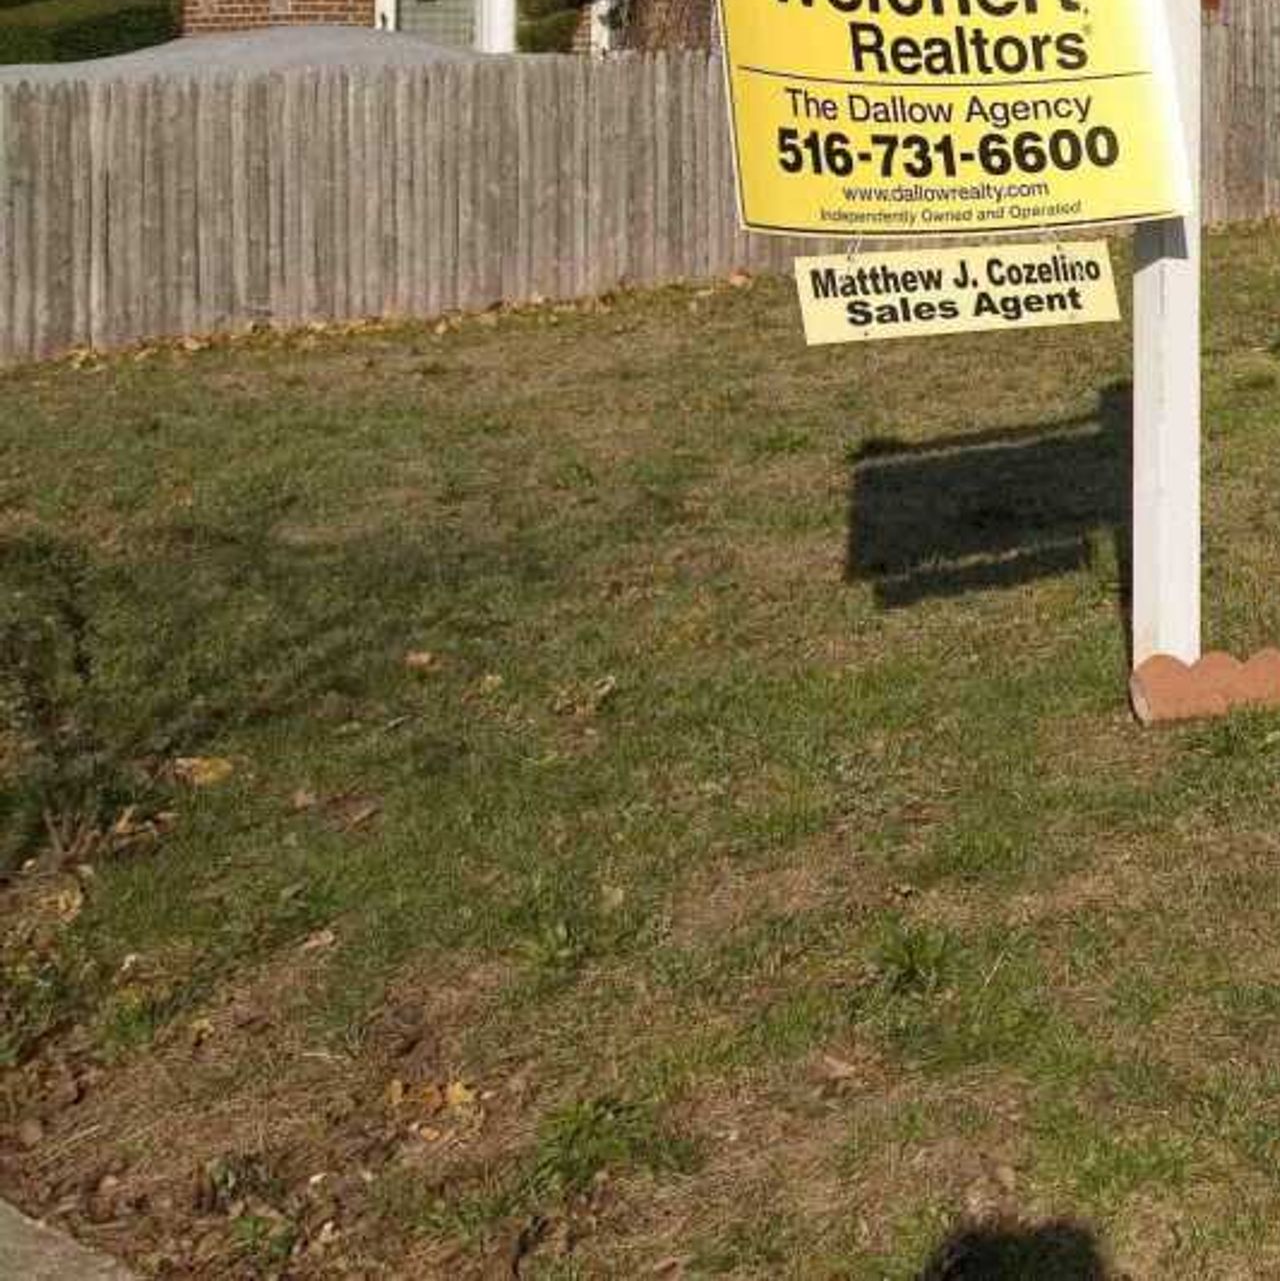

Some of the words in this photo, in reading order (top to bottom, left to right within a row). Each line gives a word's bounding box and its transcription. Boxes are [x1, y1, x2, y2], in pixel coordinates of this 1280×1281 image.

[785, 88, 838, 120] The
[849, 94, 953, 124] Dallow
[965, 95, 1092, 128] Agency
[777, 126, 1120, 179] 516-731-6600
[843, 181, 1050, 204] www.dallowrealty.com
[820, 208, 917, 224] Independently
[921, 208, 974, 222] Owned
[976, 207, 1005, 221] and
[1008, 201, 1083, 220] Operated
[810, 264, 943, 299] Matthew
[953, 260, 979, 289] J.
[847, 297, 960, 327] Sales
[974, 286, 1083, 321] Agent
